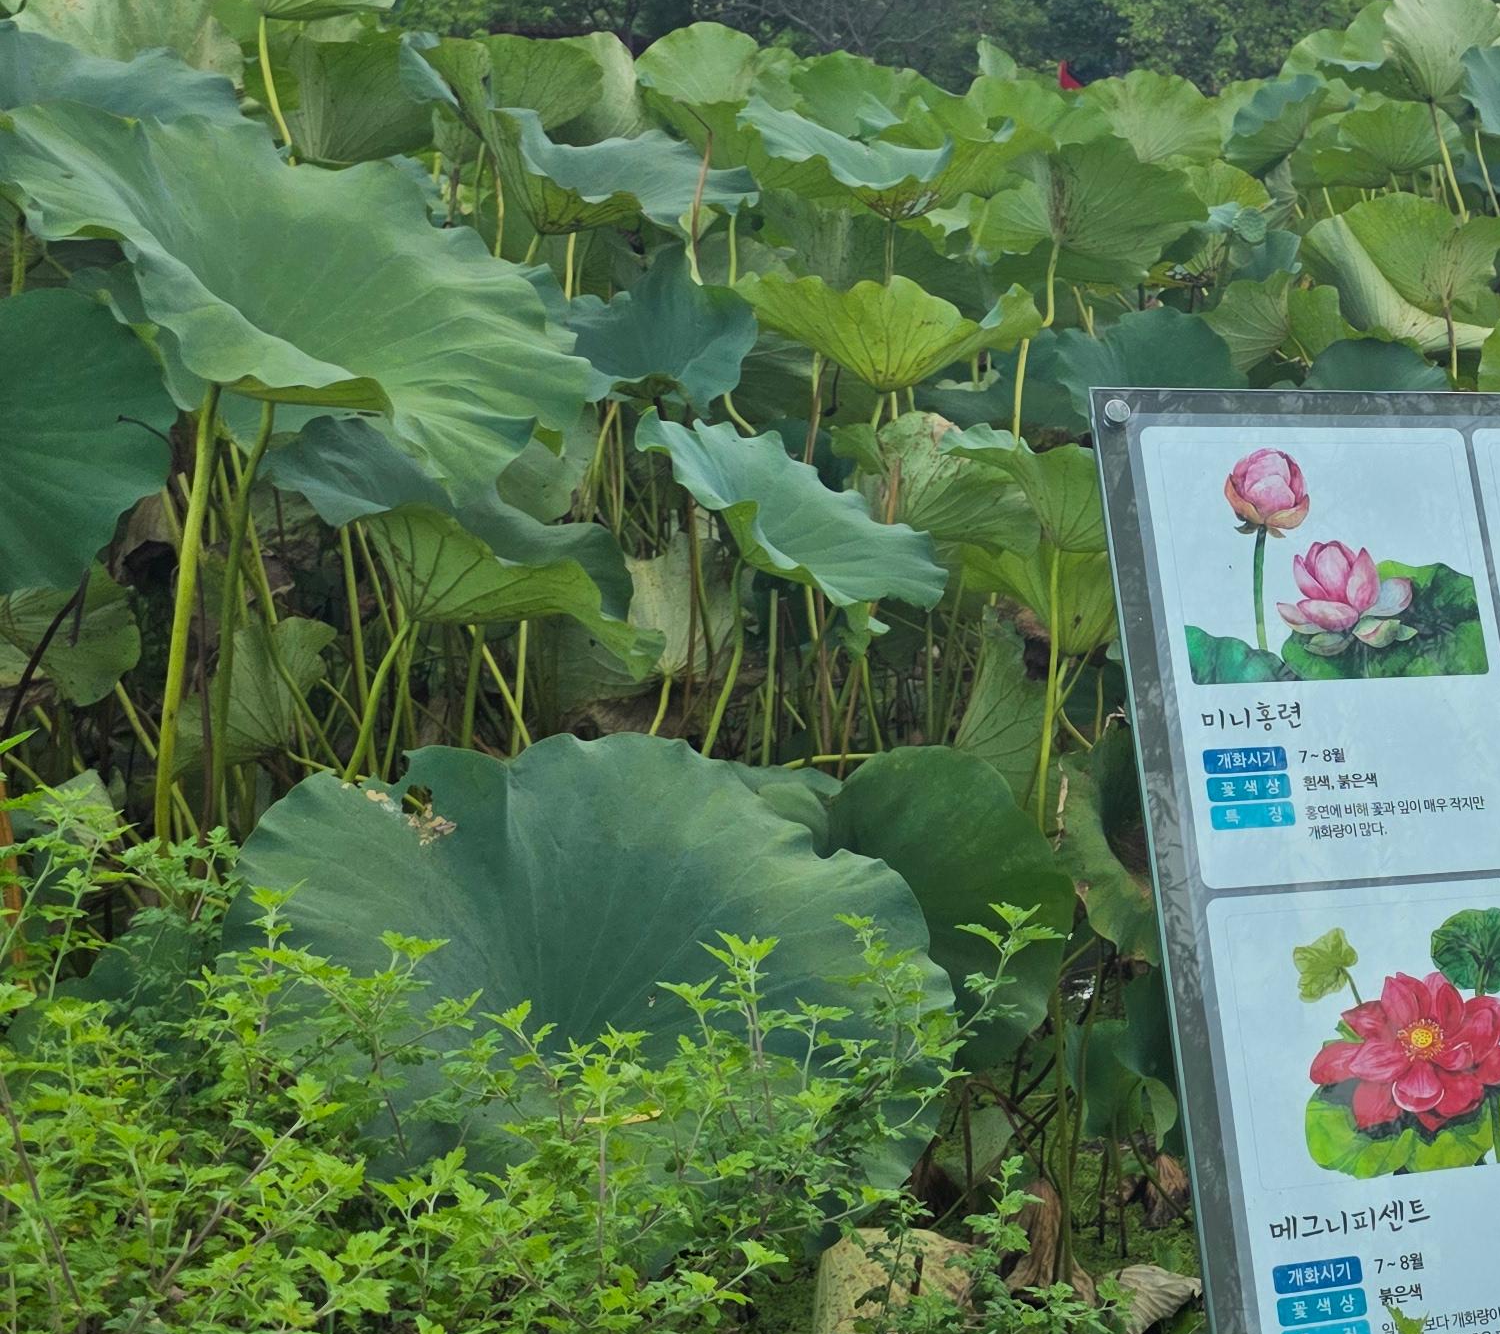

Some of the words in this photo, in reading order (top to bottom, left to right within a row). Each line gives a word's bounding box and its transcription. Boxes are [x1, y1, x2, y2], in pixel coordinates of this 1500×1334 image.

[1201, 701, 1302, 731] 미니홍련
[1216, 750, 1277, 769] 개화시기
[1337, 772, 1378, 790] 붉은색
[1305, 803, 1342, 820] 홍연에
[1344, 802, 1369, 817] 비해
[1371, 800, 1395, 816] 꽃과
[1398, 799, 1422, 815] 잎이
[1424, 797, 1448, 813] 매우
[1450, 795, 1485, 811] 작지만
[1308, 822, 1357, 840] 개화량이
[1359, 821, 1388, 837] 많다.
[1269, 1197, 1431, 1240] 메그니피센트
[1288, 1263, 1352, 1286] 개화시기
[1378, 1283, 1423, 1306] 붉은색
